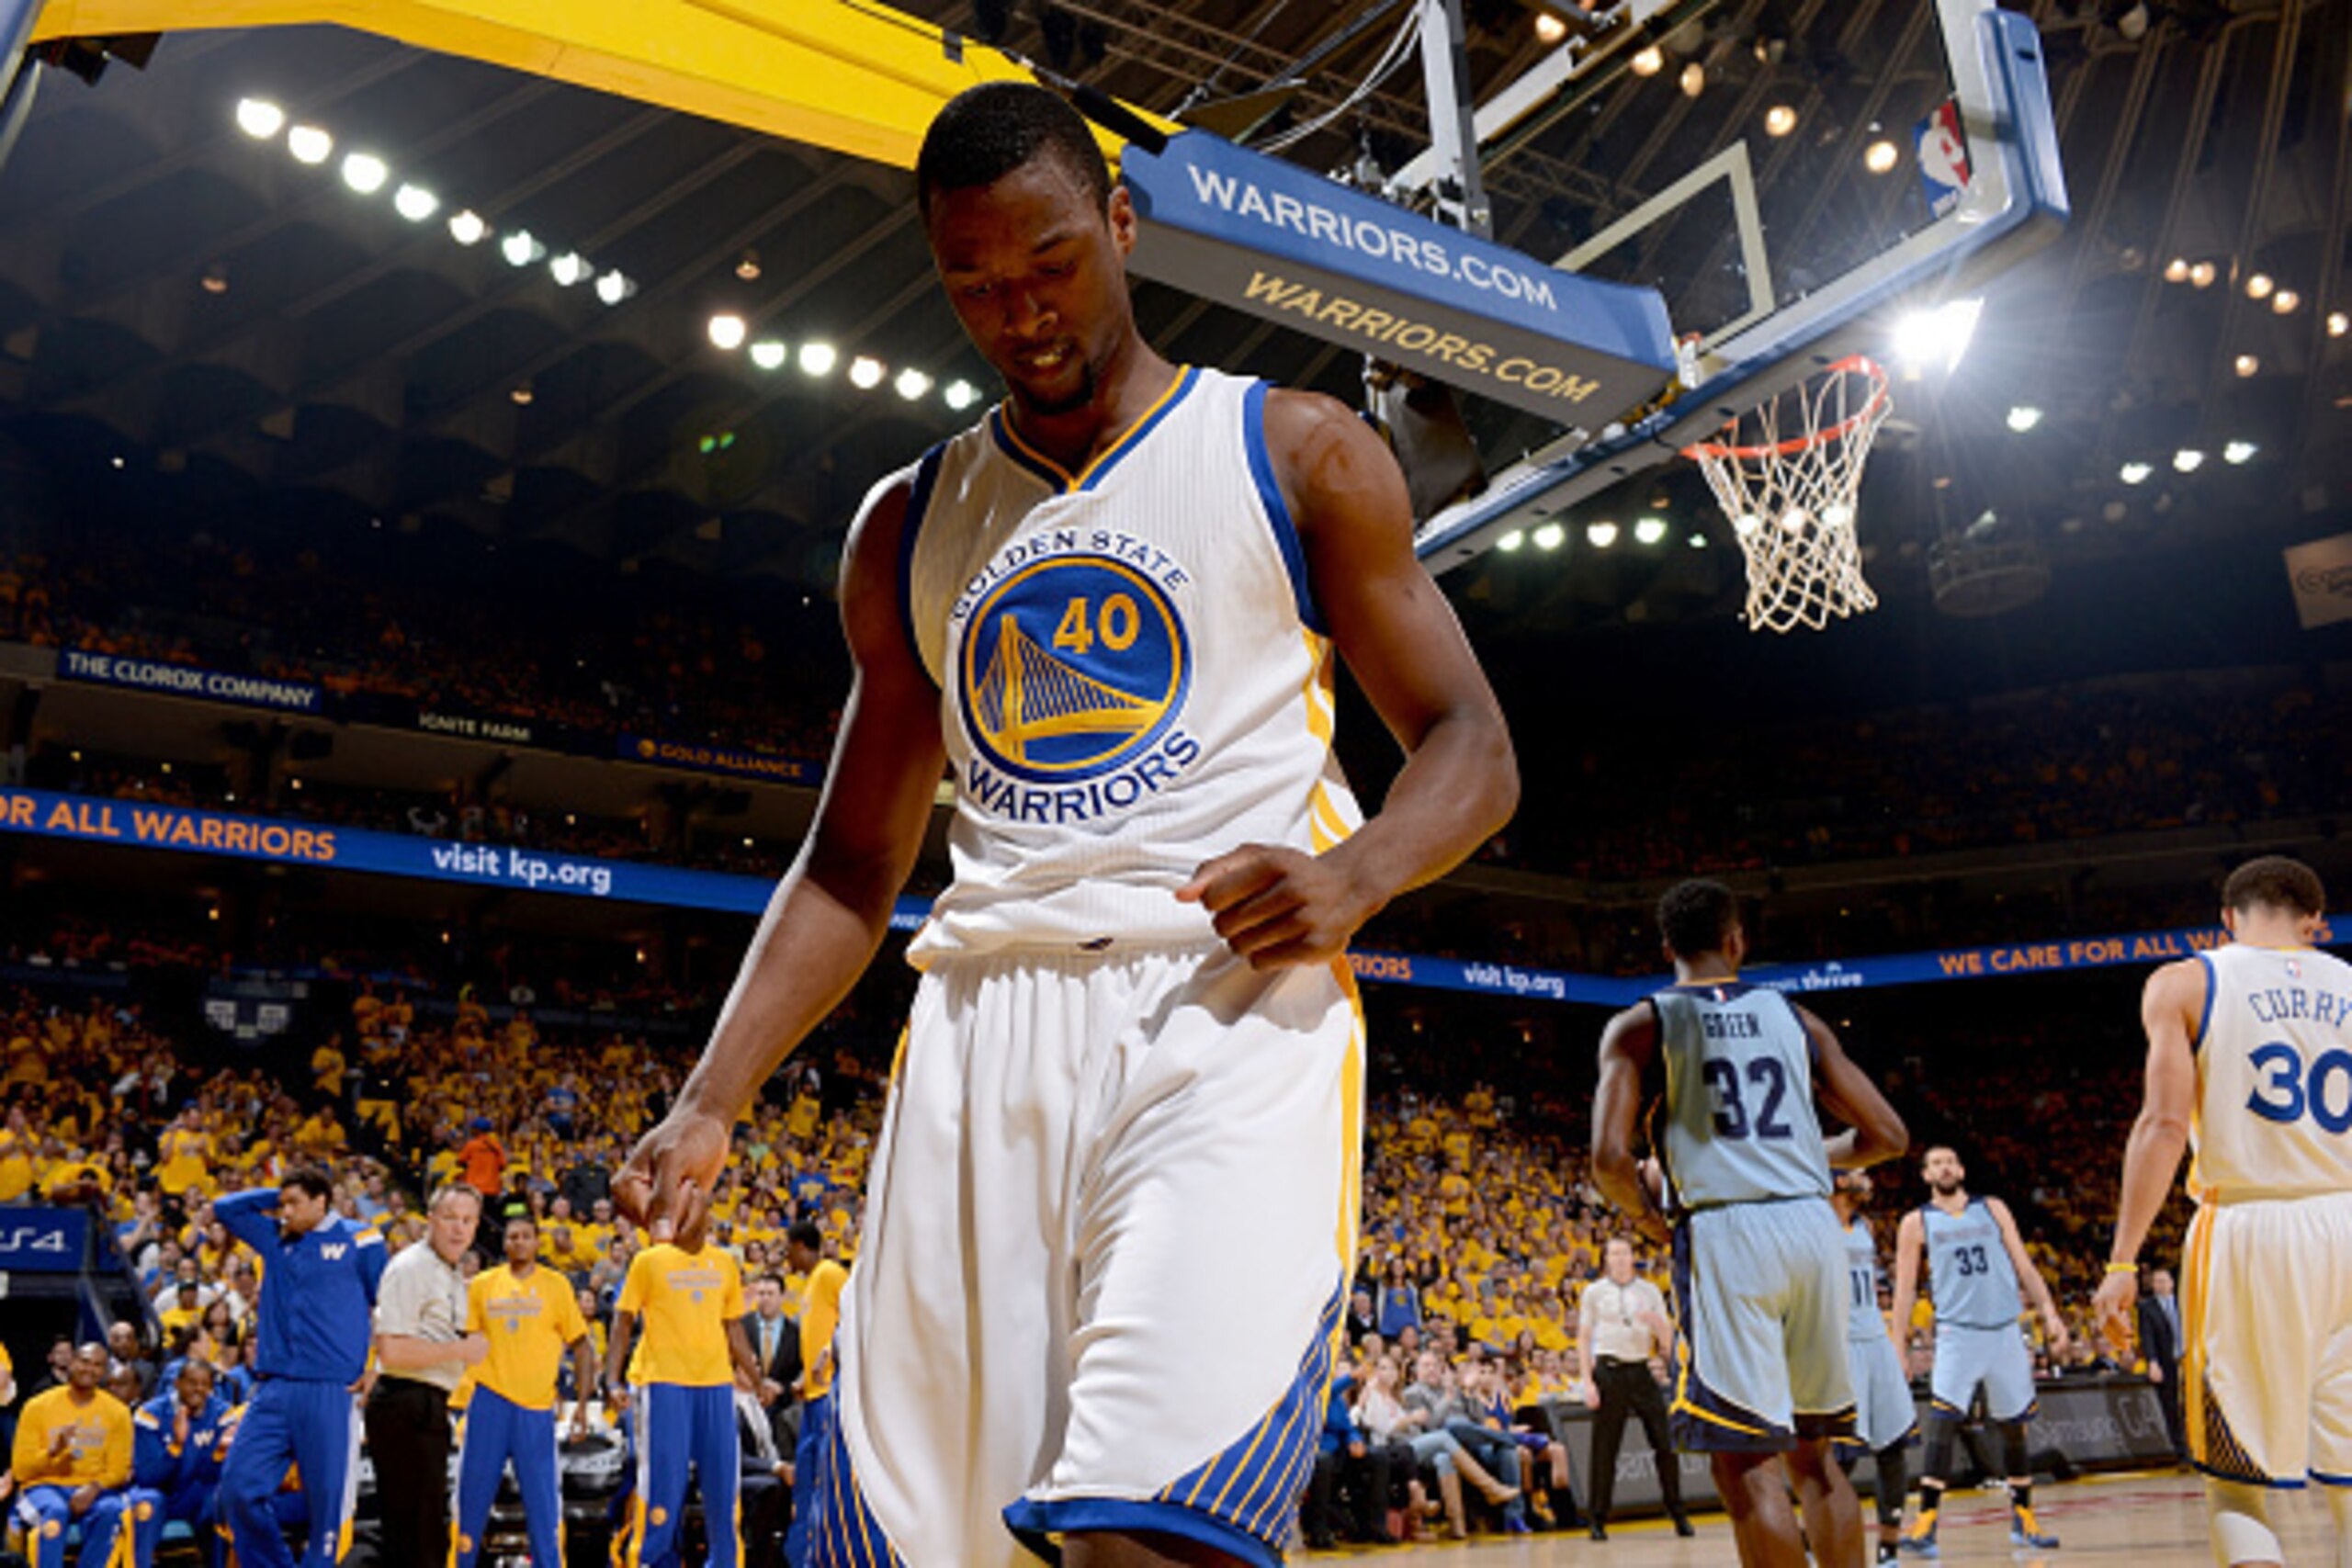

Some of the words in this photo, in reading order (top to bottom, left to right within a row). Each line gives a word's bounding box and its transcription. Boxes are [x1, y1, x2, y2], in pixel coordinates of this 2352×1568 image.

[1187, 164, 1557, 310] WARRIORS.COM
[1242, 271, 1600, 403] WARRIORS.COM
[950, 530, 1077, 622] GOLDEN
[1091, 529, 1190, 591] STATE
[1052, 593, 1141, 654] 40
[68, 652, 111, 678] THE
[114, 660, 203, 691] CLOROX
[208, 674, 314, 707] COMPANY
[714, 753, 802, 777] ALLIANCE
[967, 730, 1201, 824] WARRIORS
[46, 800, 120, 836] ALL
[133, 810, 336, 861] WARRIORS
[432, 843, 500, 876] visit
[508, 851, 612, 895] kp.org
[1464, 962, 1501, 987] visit
[1939, 952, 1984, 976] WE
[1990, 944, 2064, 971] CARE
[2068, 940, 2127, 964] FOR
[2132, 933, 2183, 959] ALL
[2248, 987, 2352, 1028] CURRY
[1702, 1056, 1792, 1140] 32
[2245, 1040, 2352, 1134] 30
[1849, 1269, 1871, 1307] 11
[1955, 1245, 1989, 1277] 33
